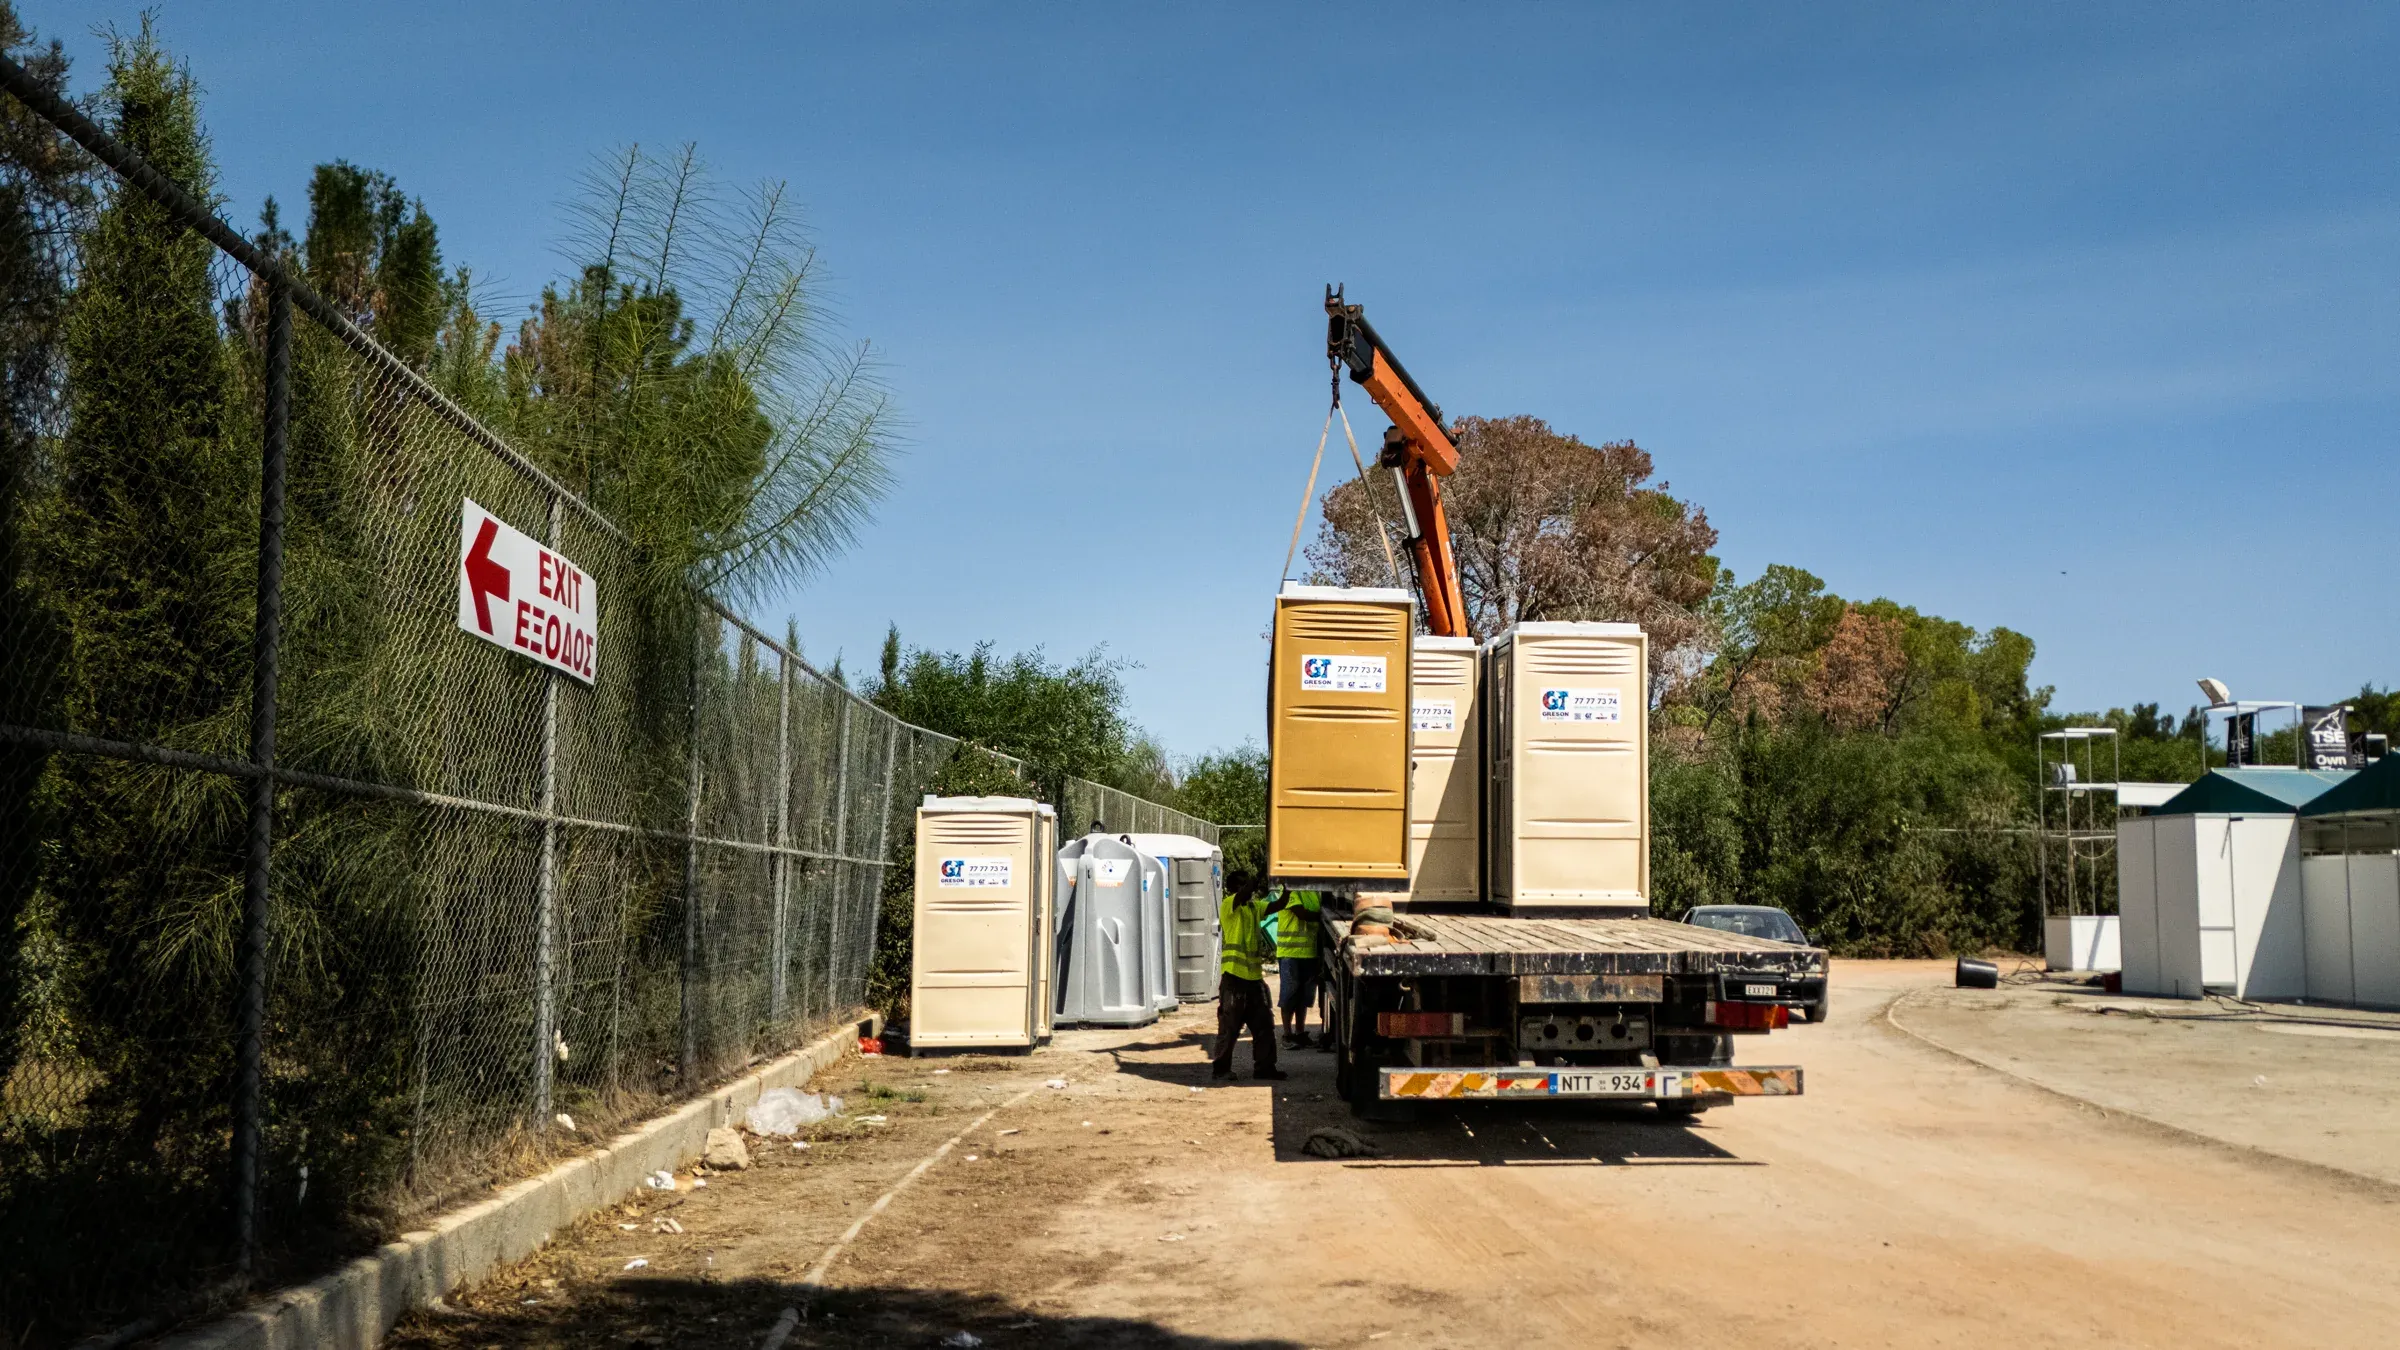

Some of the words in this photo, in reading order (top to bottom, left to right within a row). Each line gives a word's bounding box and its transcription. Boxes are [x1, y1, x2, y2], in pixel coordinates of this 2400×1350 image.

[539, 550, 582, 614] EXIT
[515, 599, 594, 678] ΕΞΟΔΟΣ
[1304, 658, 1332, 678] GT
[1542, 690, 1568, 710] GT
[2311, 731, 2346, 743] TSE
[2316, 754, 2347, 766] Own
[2352, 754, 2365, 764] SE
[941, 860, 965, 878] GT
[1562, 1076, 1593, 1091] NTT
[1612, 1076, 1641, 1090] 934
